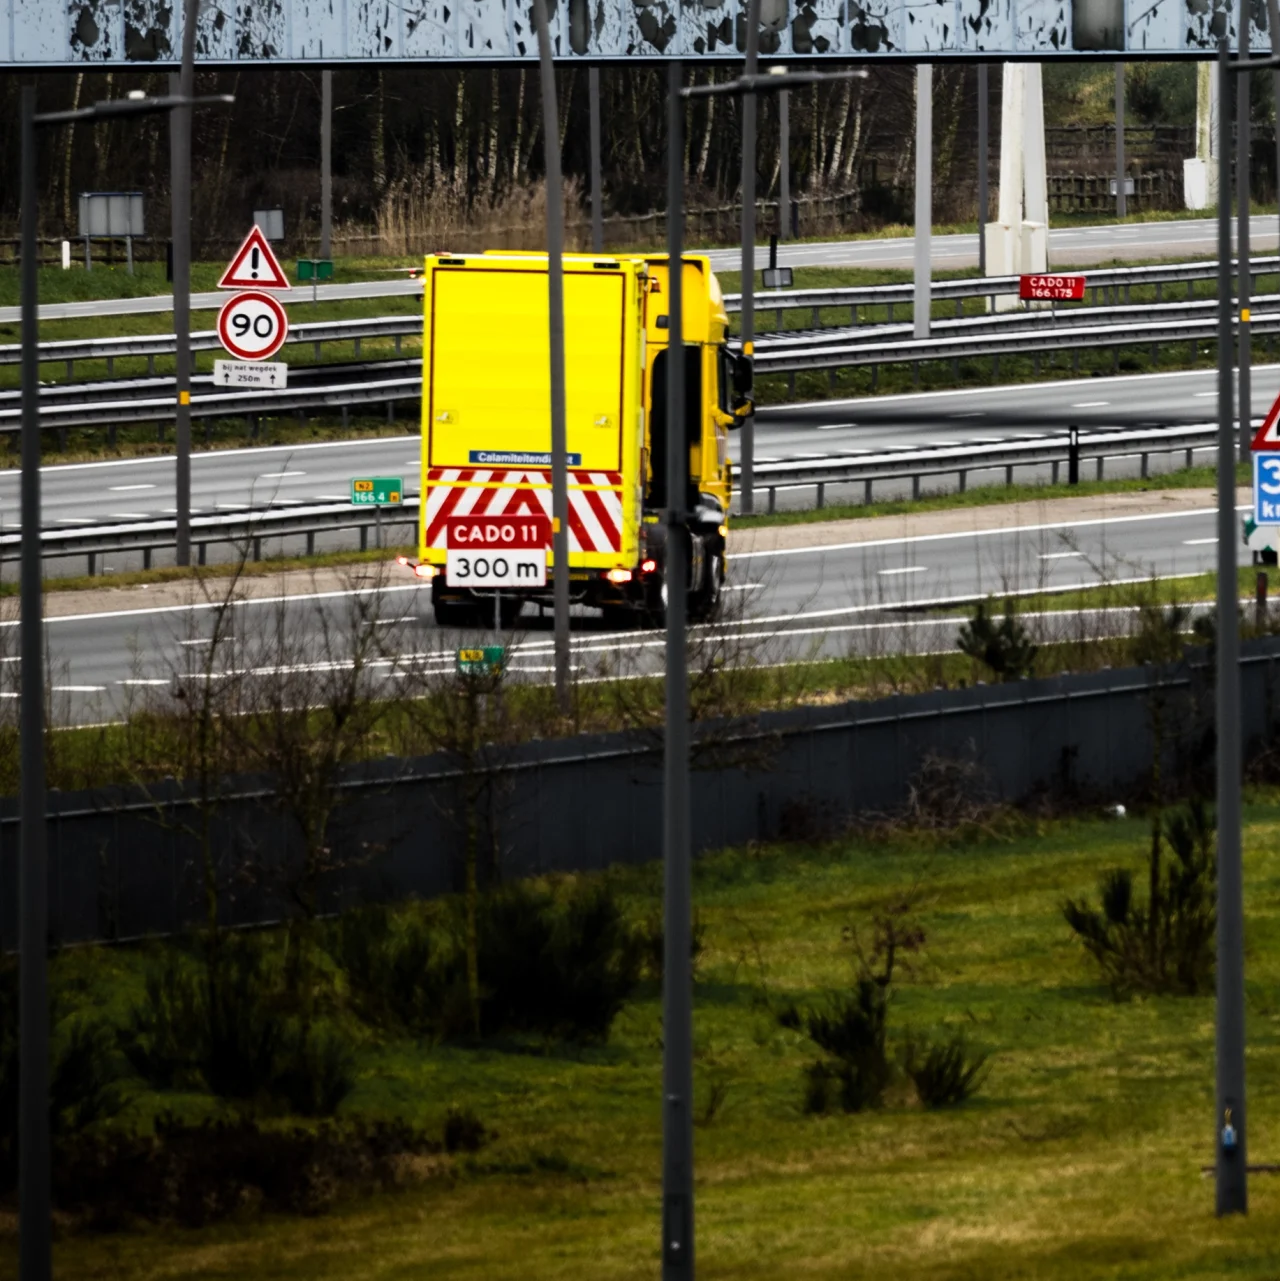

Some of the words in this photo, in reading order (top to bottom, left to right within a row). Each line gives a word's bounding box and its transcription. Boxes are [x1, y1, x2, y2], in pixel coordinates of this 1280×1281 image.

[1030, 278, 1063, 287] CADO
[1067, 278, 1075, 287] 11
[1031, 288, 1073, 298] 166.175
[232, 313, 273, 338] 90
[222, 364, 233, 372] bij
[453, 525, 515, 542] CADO
[521, 525, 537, 542] 11
[455, 558, 509, 578] 300
[517, 562, 538, 578] m
